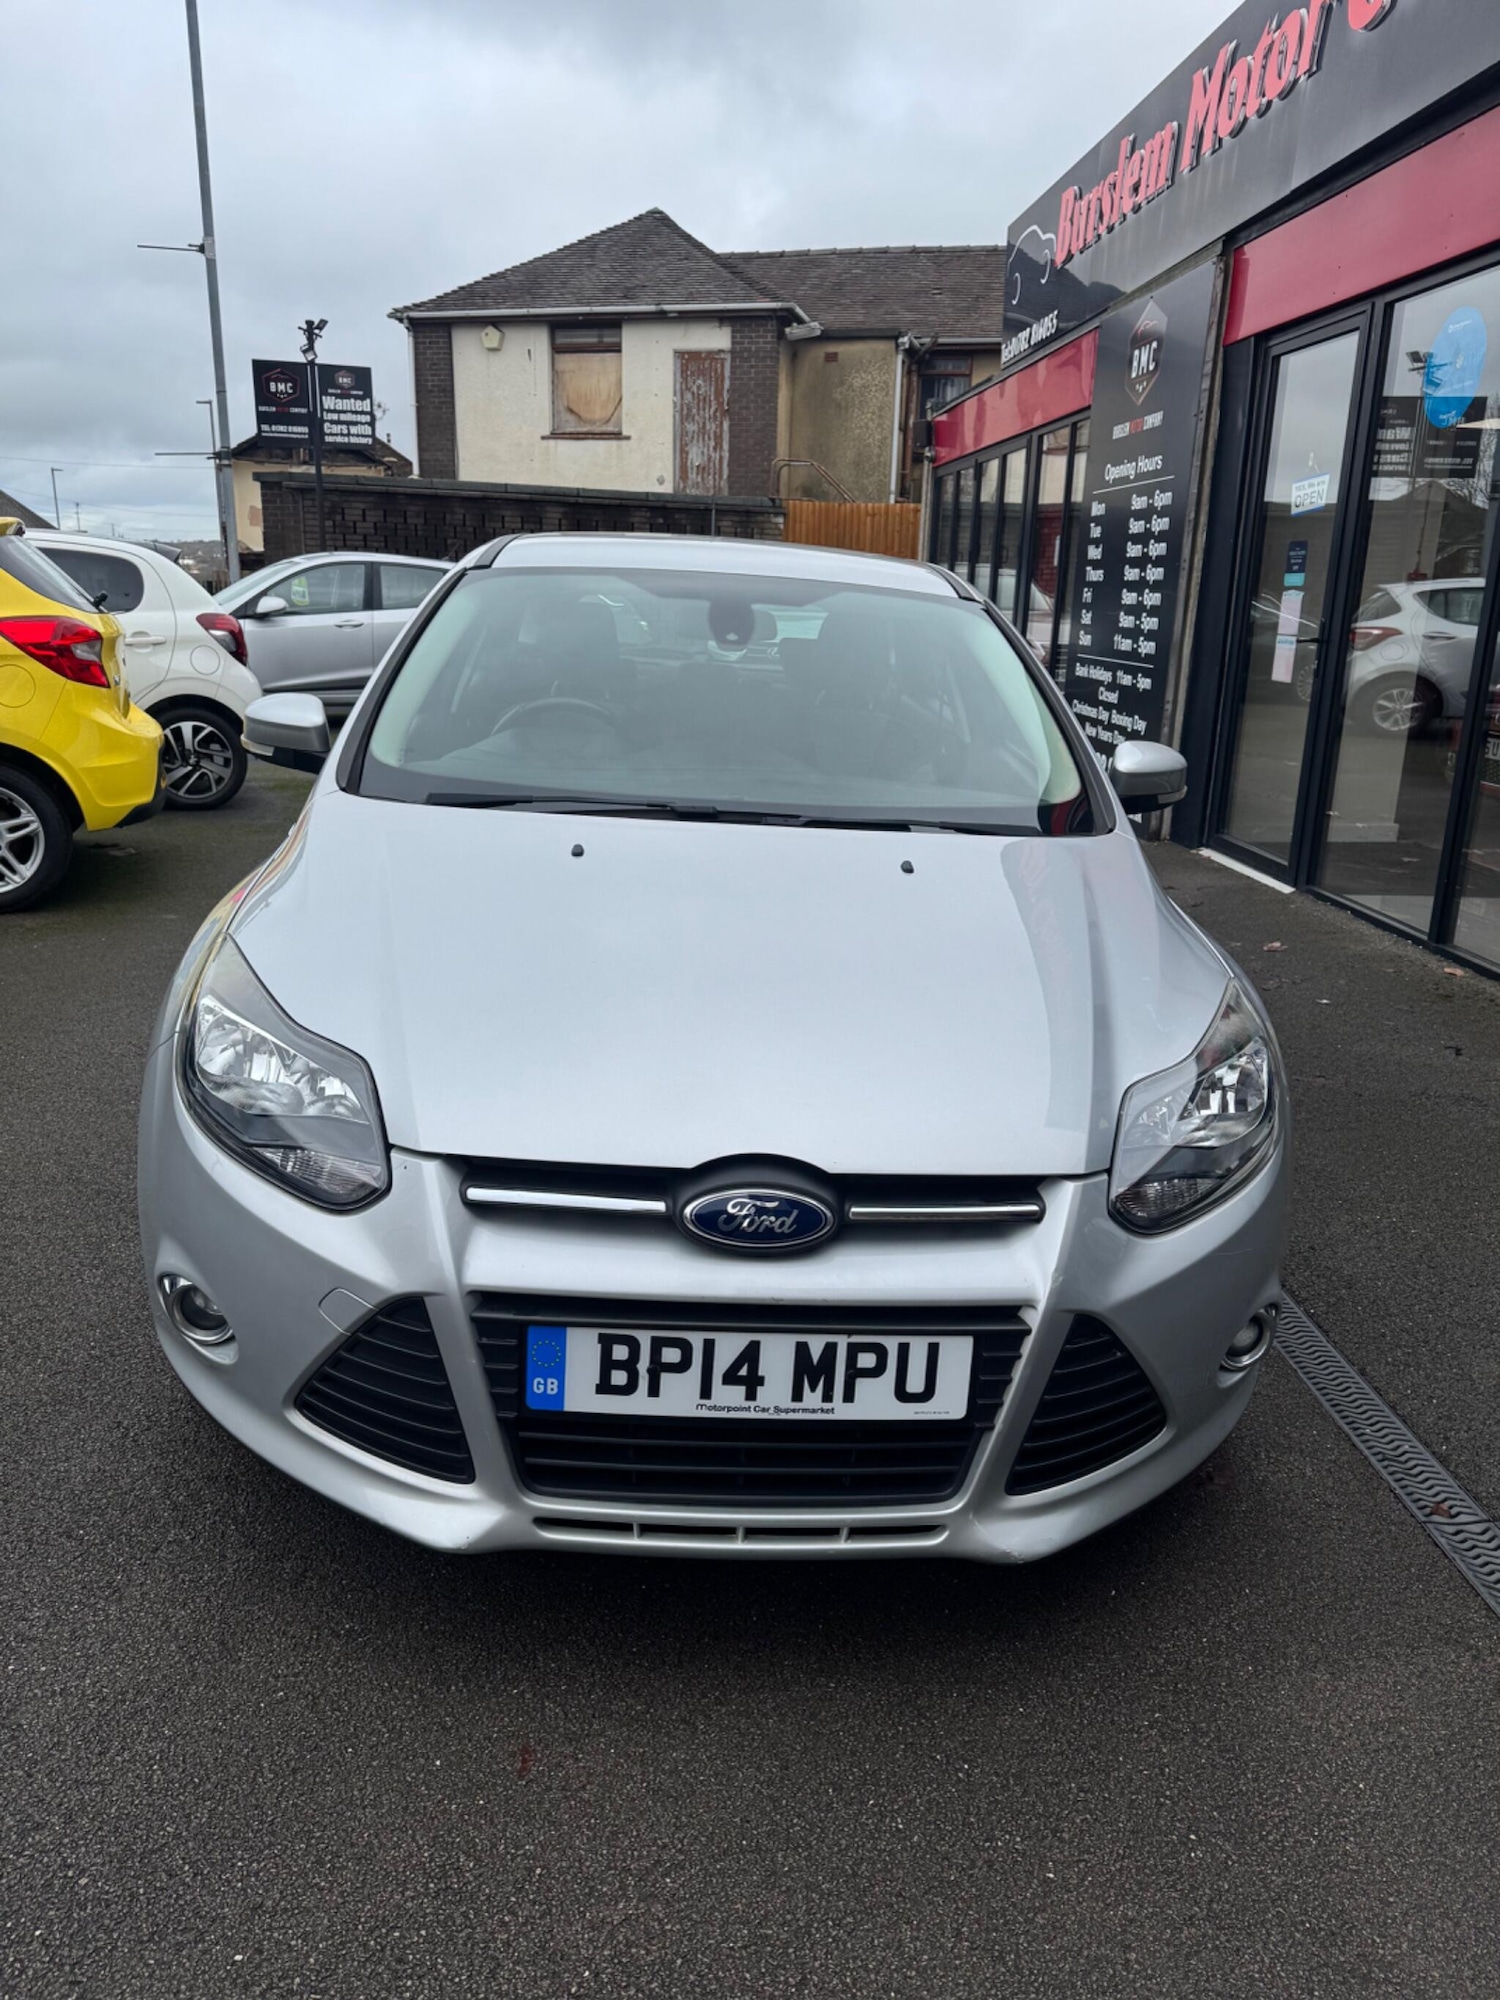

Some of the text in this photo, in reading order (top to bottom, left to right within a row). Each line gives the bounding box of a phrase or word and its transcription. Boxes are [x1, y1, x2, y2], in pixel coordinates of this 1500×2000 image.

[1055, 0, 1335, 268] Burslem Motor
[1131, 340, 1158, 379] BMC
[269, 381, 294, 393] BMC
[322, 395, 371, 412] Wanted
[323, 411, 371, 423] Low mileage
[323, 422, 372, 436] Cars with
[324, 435, 373, 445] service history
[1104, 455, 1163, 484] Opening Hours
[1090, 500, 1106, 517] Mon
[1131, 493, 1148, 510] 9am
[1153, 489, 1173, 511] 6pm
[1294, 488, 1326, 508] OPEN
[1090, 522, 1102, 538] Tue
[1128, 517, 1145, 534] 9am
[1151, 514, 1170, 536] 6pm
[1087, 543, 1103, 560] Wed
[1126, 541, 1143, 558] 9am
[1148, 539, 1167, 560] 6pm
[1085, 566, 1104, 582] Thurs
[1124, 564, 1140, 581] 9am
[1146, 563, 1164, 585] 6pm
[1082, 587, 1093, 603] Fri
[1121, 588, 1138, 605] 9am
[1143, 588, 1161, 610] 6pm
[1081, 609, 1092, 625] Sat
[1118, 611, 1135, 628] 9am
[1140, 612, 1159, 634] 5pm
[1078, 630, 1092, 646] Sun
[1113, 633, 1133, 652] 11am
[1138, 636, 1156, 658] 5pm
[1075, 662, 1089, 678] Bank
[1089, 664, 1113, 685] Holidays
[1116, 669, 1133, 686] 11am
[1137, 673, 1152, 692] 5pm
[1098, 686, 1119, 704] Closed
[1072, 699, 1148, 736] Christmas Day Boxing Day
[1085, 721, 1097, 738] New
[1097, 725, 1113, 743] Years
[717, 1195, 799, 1236] Ford
[595, 1332, 940, 1404] BP14 MPU
[533, 1377, 558, 1395] GB
[753, 1405, 770, 1414] Car
[772, 1406, 835, 1416] Supermarket
